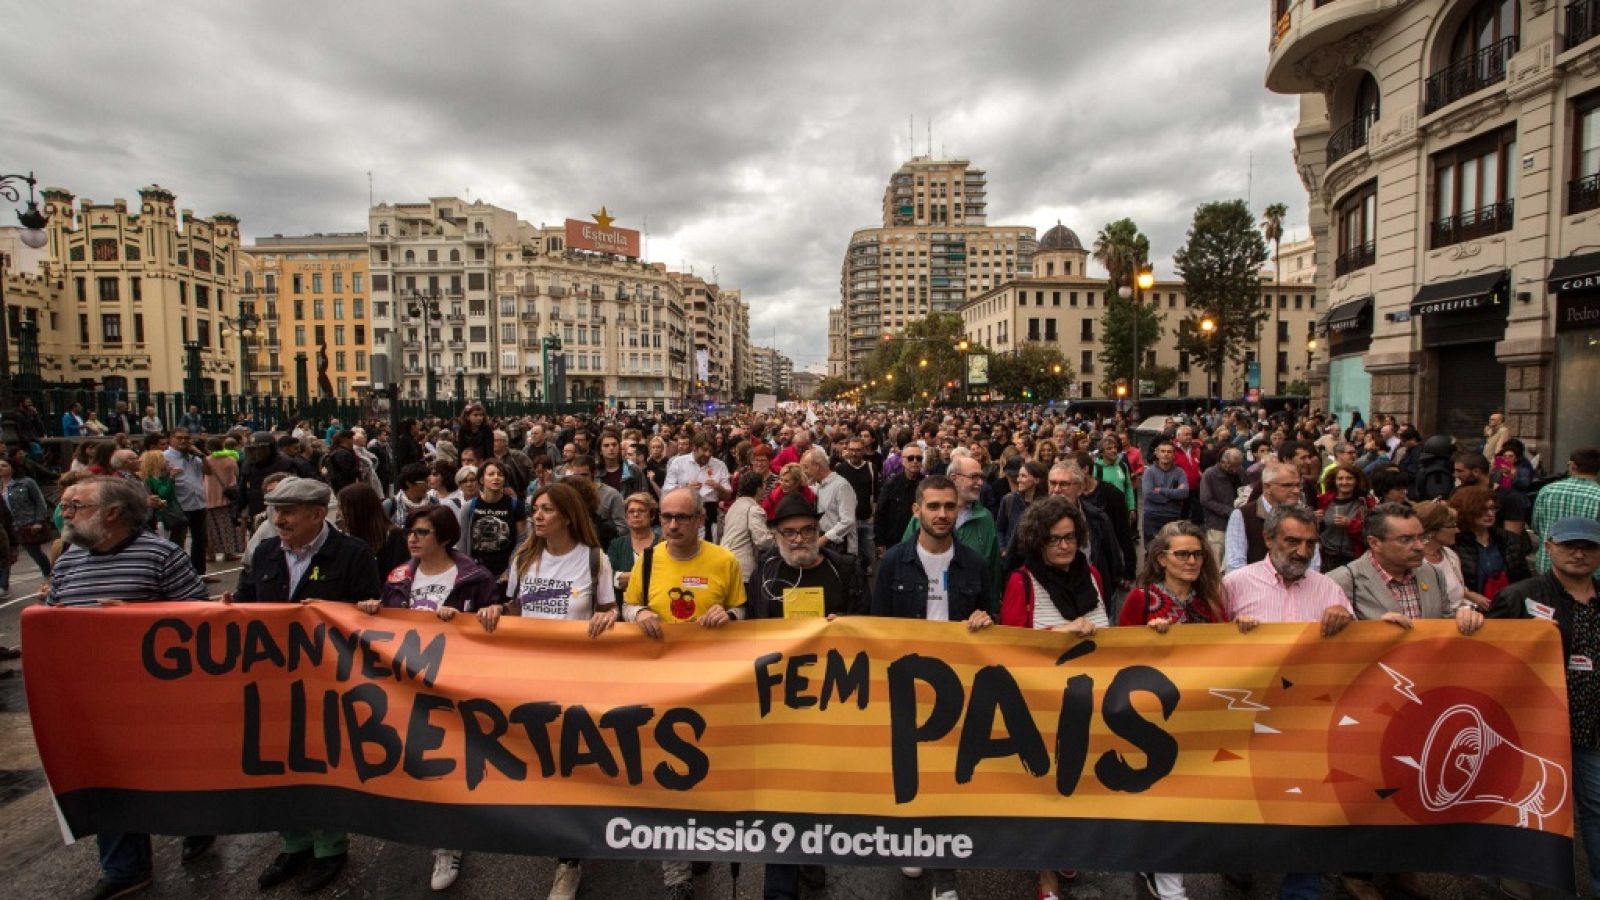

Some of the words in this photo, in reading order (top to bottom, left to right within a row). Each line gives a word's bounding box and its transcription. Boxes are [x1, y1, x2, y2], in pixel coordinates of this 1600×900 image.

[582, 225, 627, 246] Estrella
[1420, 297, 1479, 314] CORTEFIEL
[1567, 305, 1600, 321] Pedro
[524, 577, 573, 588] LLIBERTAT
[141, 618, 446, 687] GUANYEM
[242, 680, 709, 791] LLIBERTATS
[754, 648, 870, 718] FEM
[887, 640, 1181, 804] PAÍS
[605, 817, 765, 852] Comissió
[771, 823, 795, 853] 9
[800, 823, 973, 859] d'octubre
